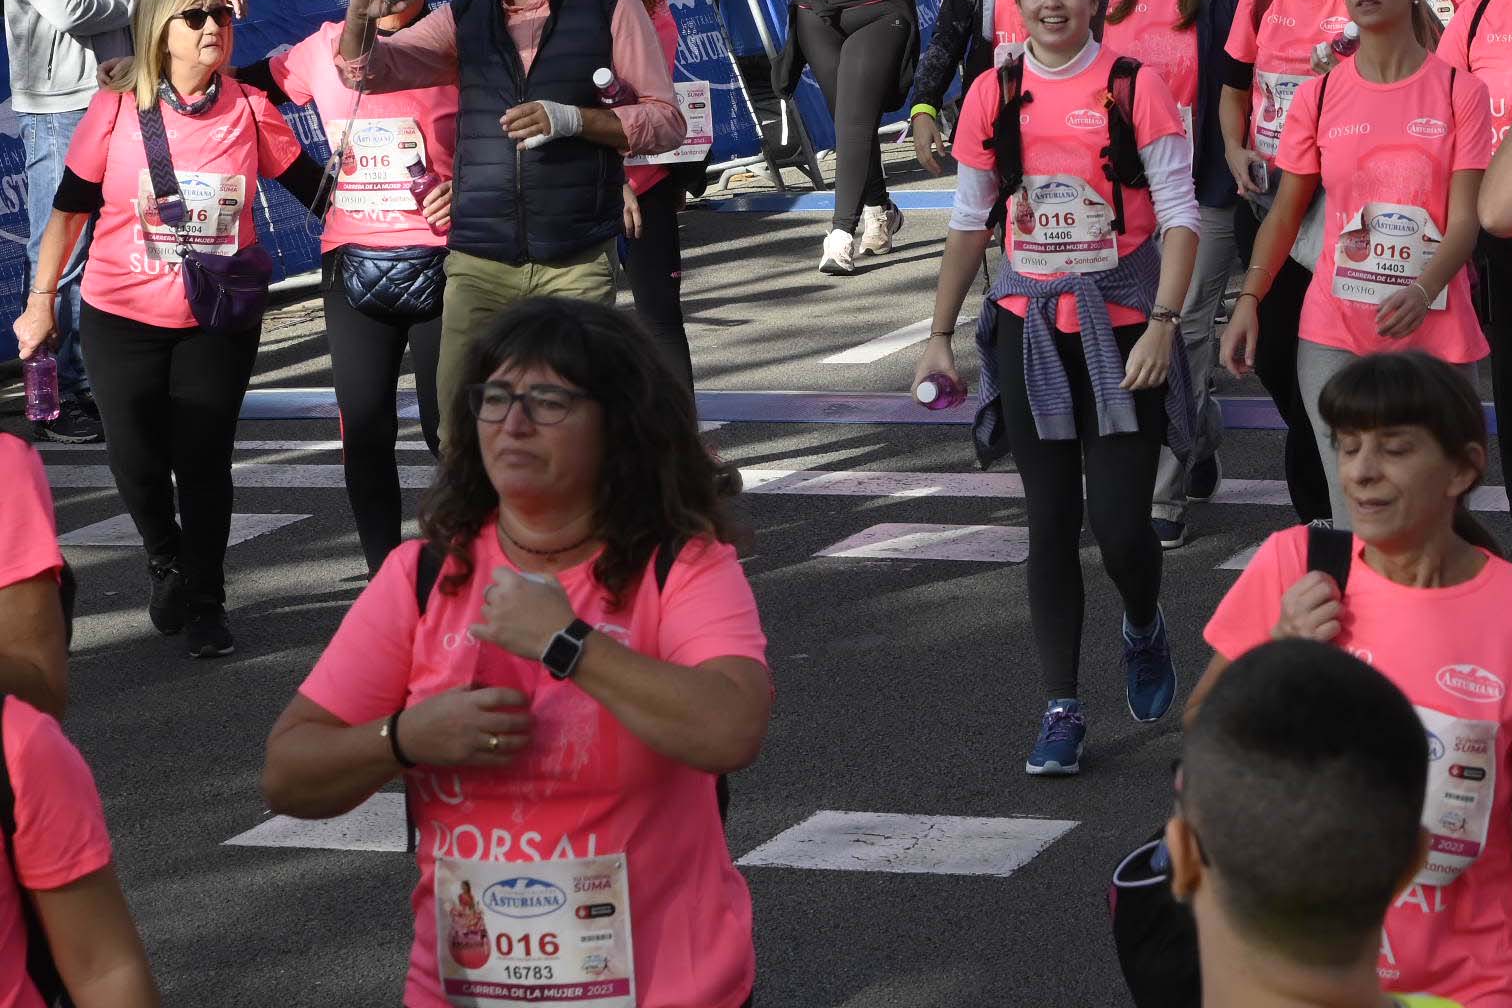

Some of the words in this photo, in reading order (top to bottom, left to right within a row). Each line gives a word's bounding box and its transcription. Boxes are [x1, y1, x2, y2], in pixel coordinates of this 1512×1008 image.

[1329, 123, 1370, 139] OYSHO
[360, 155, 390, 168] 016
[1039, 212, 1076, 228] 016
[1373, 220, 1418, 233] ASTURIANA
[1043, 231, 1073, 241] 14406
[1374, 243, 1412, 260] 016
[1347, 270, 1375, 281] CARRERA
[1376, 262, 1405, 274] 14403
[1342, 283, 1375, 296] OYSHO
[1440, 672, 1500, 697] ASTURIANA
[573, 880, 612, 892] SUMA
[487, 890, 561, 908] ASTURIANA
[496, 932, 560, 957] 016
[504, 965, 554, 981] 16783
[461, 983, 508, 997] CARRERA
[509, 986, 525, 997] DE
[526, 987, 542, 998] LA
[543, 987, 584, 1000] MUJER
